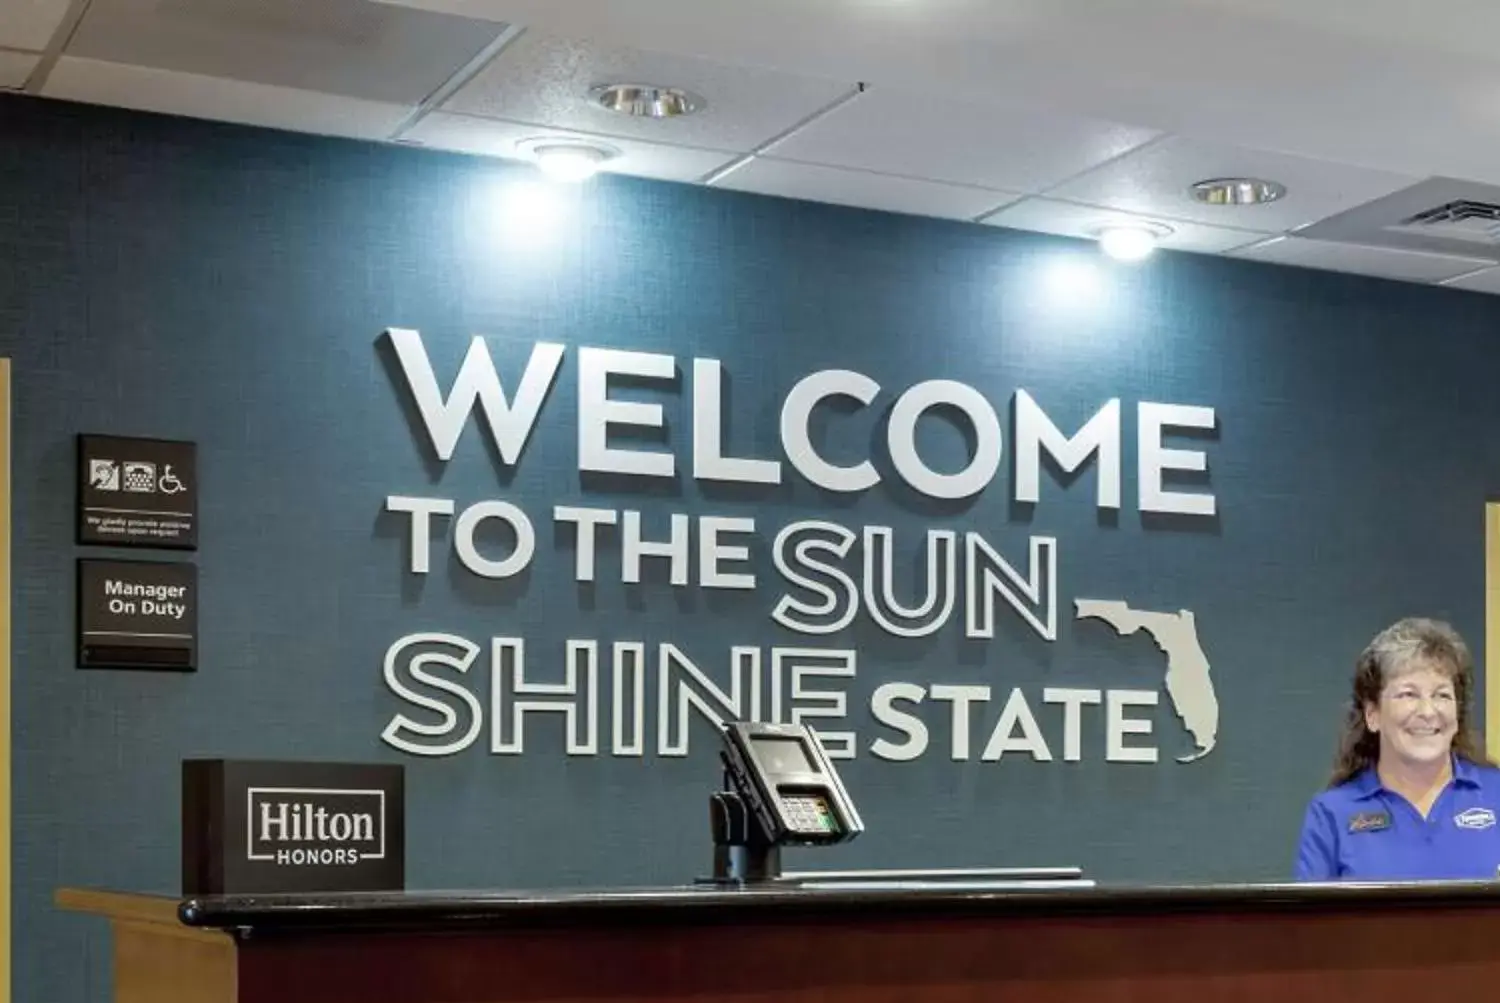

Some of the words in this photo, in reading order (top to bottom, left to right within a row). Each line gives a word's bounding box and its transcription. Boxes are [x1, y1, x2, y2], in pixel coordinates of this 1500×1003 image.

[384, 326, 1217, 516] WELCOME
[386, 495, 535, 579] TO
[553, 505, 756, 589] THE
[771, 520, 1057, 640] SUN
[105, 580, 187, 600] Manager
[109, 600, 136, 615] On
[141, 601, 186, 619] Duty
[381, 632, 858, 760] SHINE
[869, 682, 1159, 763] STATE
[259, 802, 375, 841] Hilton
[277, 849, 359, 865] HONORS
